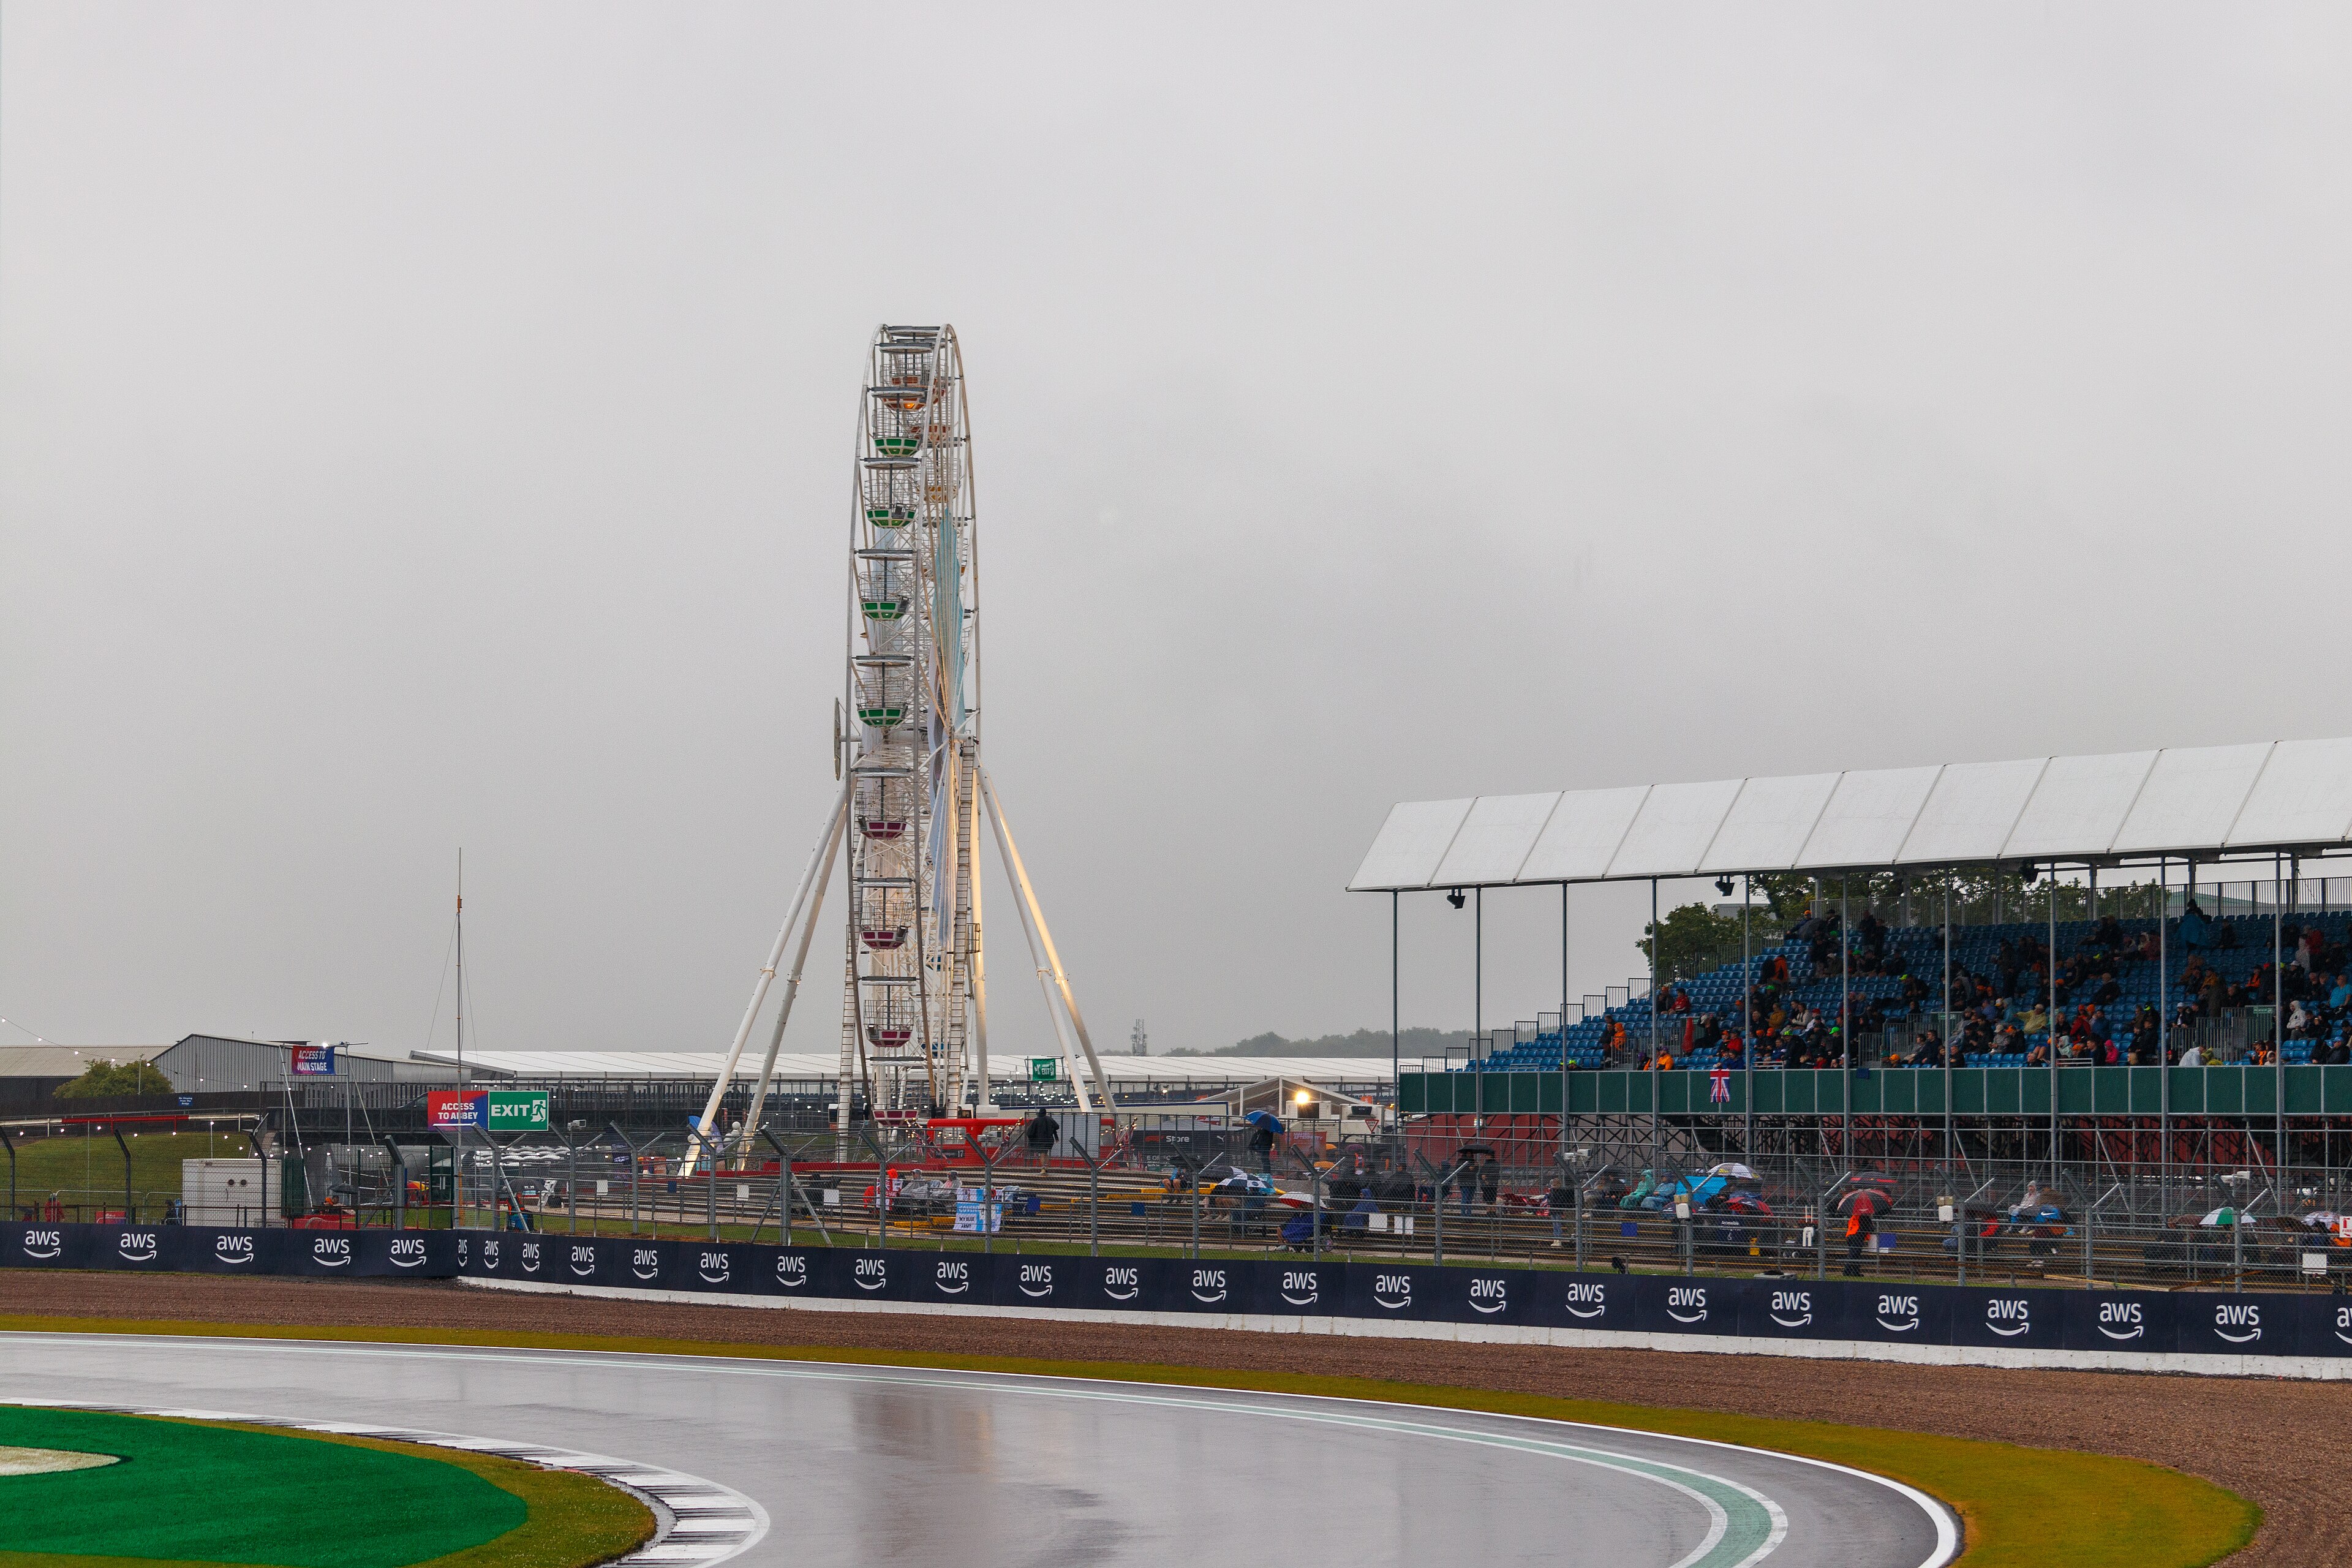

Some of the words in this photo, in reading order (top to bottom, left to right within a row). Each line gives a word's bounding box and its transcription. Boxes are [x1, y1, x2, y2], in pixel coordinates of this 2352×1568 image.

[298, 1050, 318, 1060] ACCESS
[319, 1050, 326, 1060] TO
[297, 1061, 311, 1071] MAIN
[311, 1062, 327, 1071] STAGE
[491, 1104, 530, 1116] EXIT
[25, 1231, 59, 1245] aws
[120, 1234, 155, 1248] aws
[216, 1236, 252, 1251] aws
[314, 1238, 349, 1253] aws
[391, 1239, 424, 1254] aws
[458, 1239, 467, 1254] aws
[484, 1240, 499, 1256] aws
[522, 1243, 540, 1259] aws
[571, 1246, 594, 1262] aws
[634, 1250, 657, 1265] aws
[701, 1253, 728, 1269] aws
[778, 1256, 805, 1273] aws
[856, 1259, 884, 1275] aws
[937, 1262, 967, 1279] aws
[1021, 1265, 1051, 1282] aws
[1106, 1268, 1137, 1284] aws
[1193, 1270, 1225, 1287] aws
[1283, 1272, 1316, 1289] aws
[1376, 1275, 1409, 1293] aws
[1471, 1280, 1504, 1297] aws
[1568, 1284, 1604, 1302] aws
[1669, 1288, 1705, 1306] aws
[1772, 1292, 1810, 1311] aws
[1879, 1295, 1917, 1315] aws
[1988, 1300, 2027, 1319] aws
[2100, 1303, 2141, 1322] aws
[2216, 1305, 2259, 1325] aws
